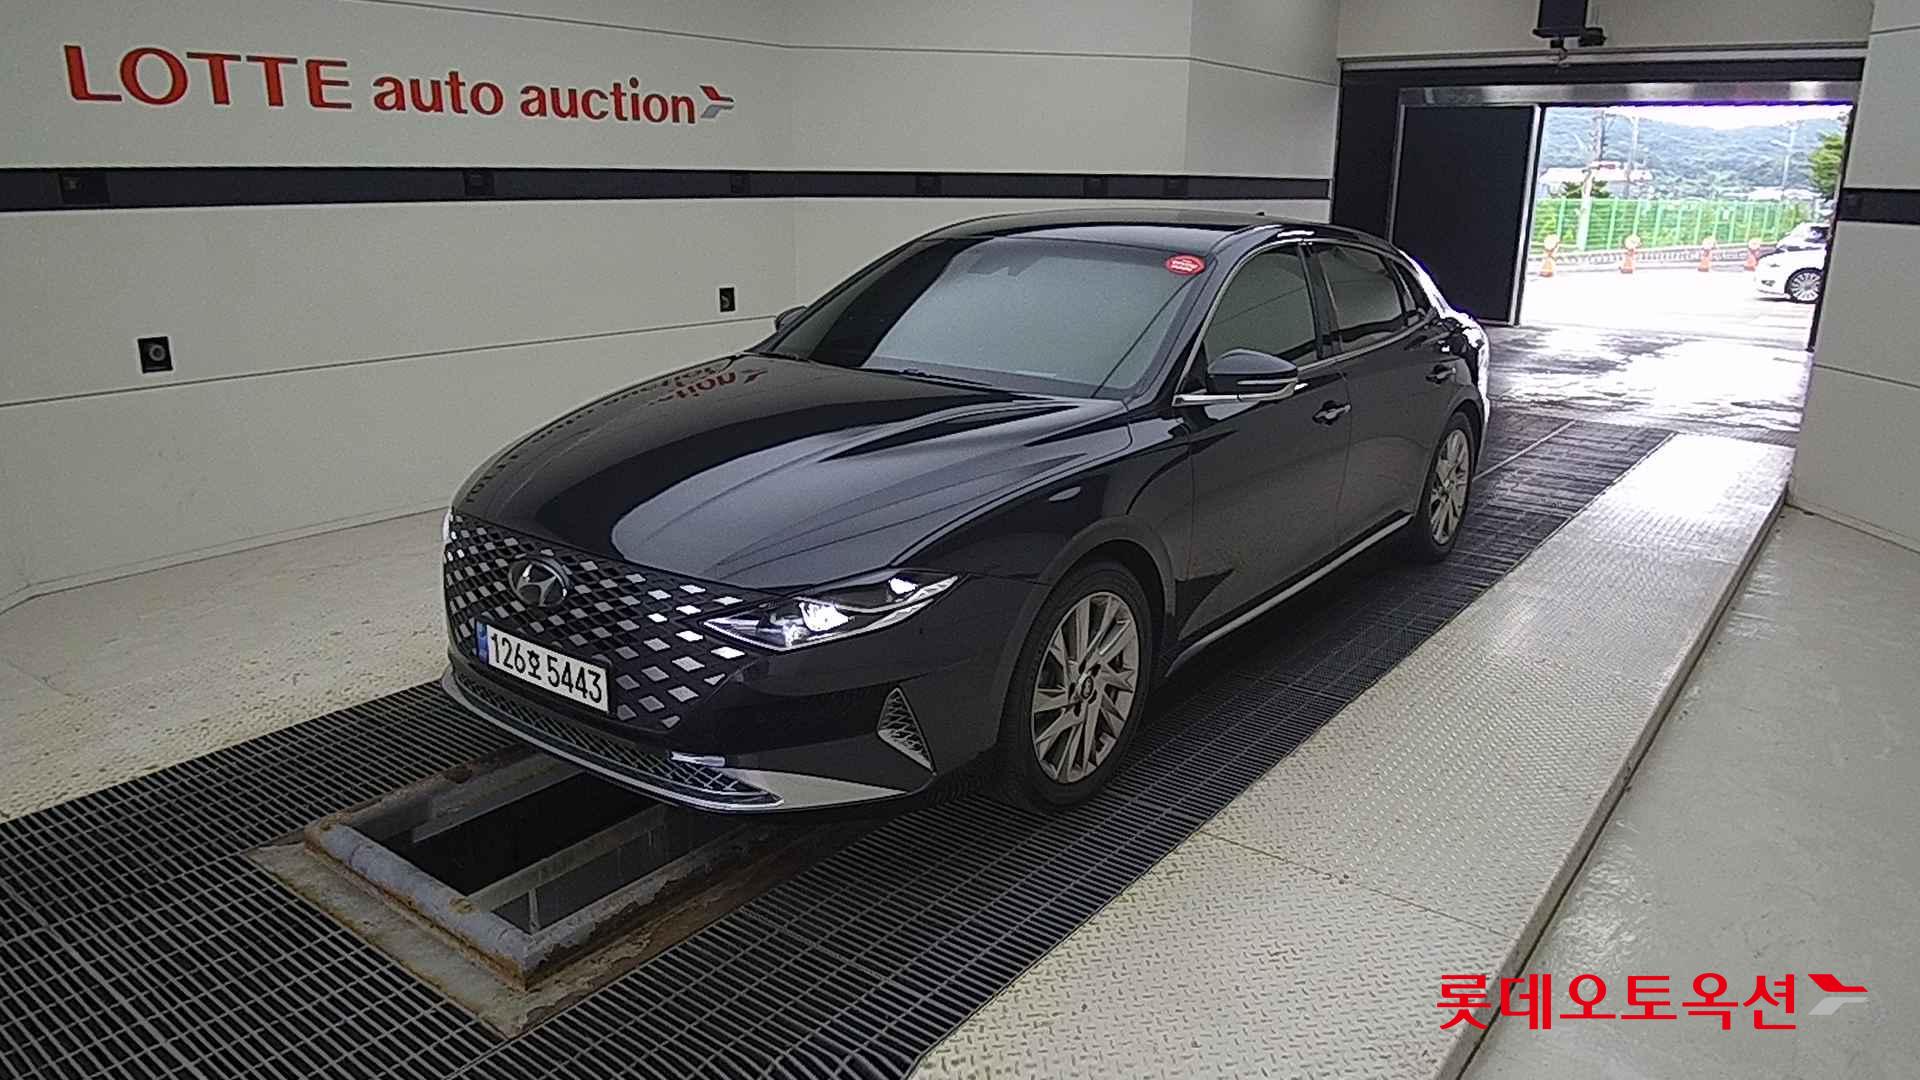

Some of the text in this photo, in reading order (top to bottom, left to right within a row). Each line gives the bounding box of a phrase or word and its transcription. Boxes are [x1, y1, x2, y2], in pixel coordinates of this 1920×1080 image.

[64, 44, 697, 124] LOTTE auto auction
[546, 654, 602, 703] 5443
